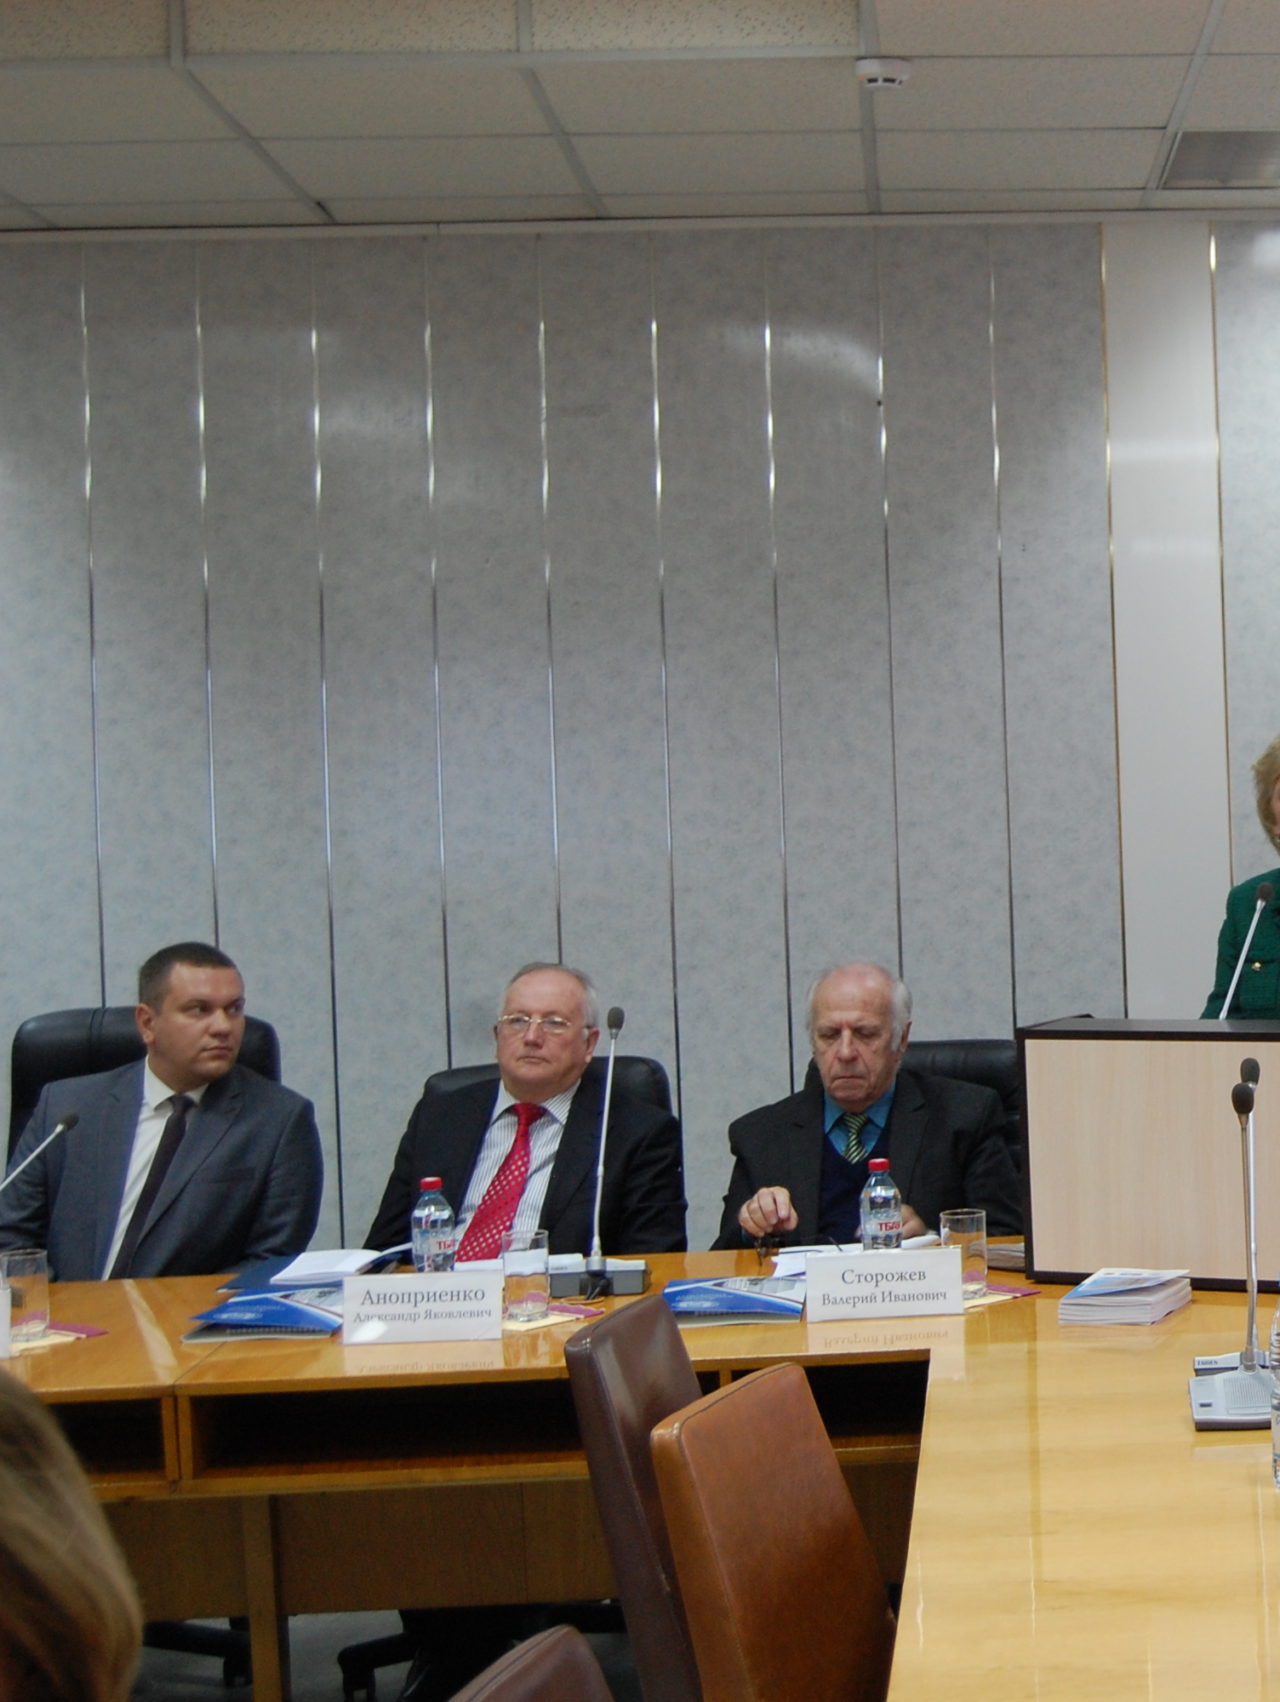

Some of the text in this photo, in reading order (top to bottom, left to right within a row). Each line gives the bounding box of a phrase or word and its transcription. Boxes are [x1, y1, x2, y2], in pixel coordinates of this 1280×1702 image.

[841, 1269, 927, 1287] Сторожев
[360, 1288, 486, 1308] Аноприенко
[821, 1290, 948, 1308] Валерий Иванович
[353, 1309, 492, 1324] Александр Яковлевич
